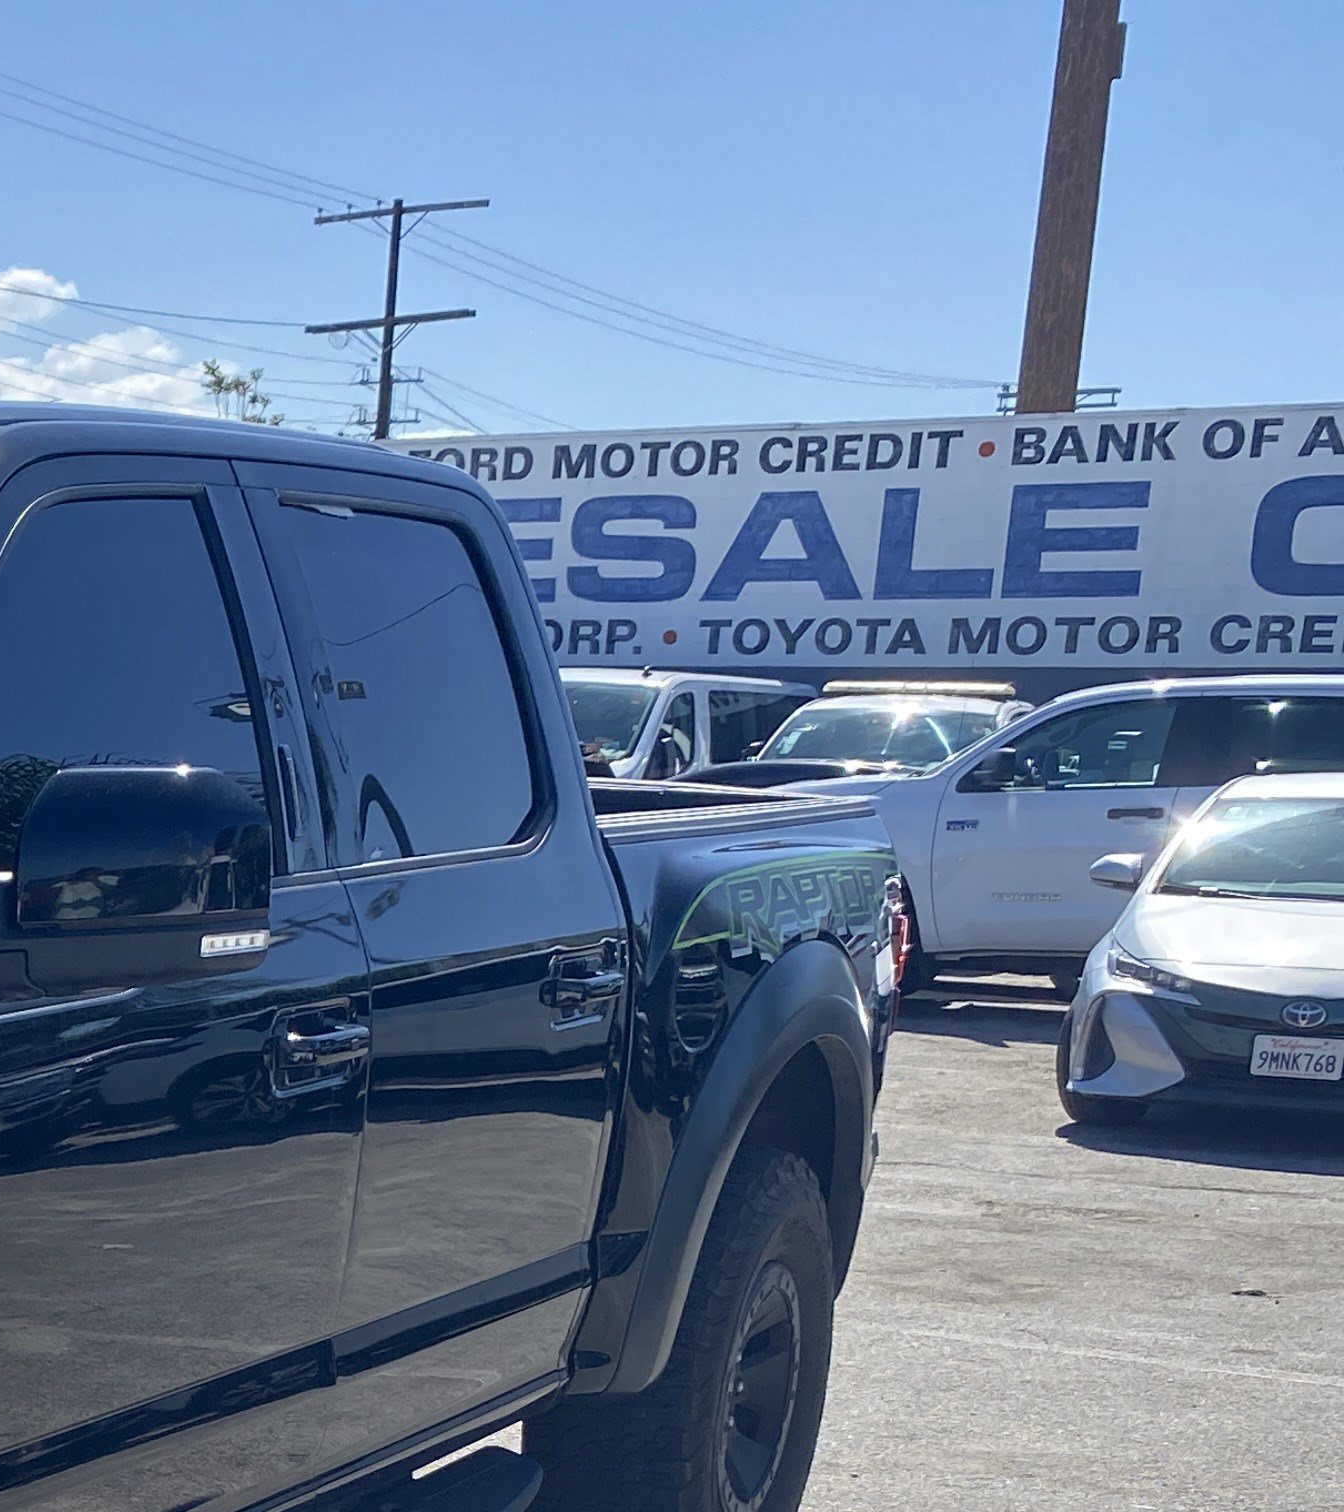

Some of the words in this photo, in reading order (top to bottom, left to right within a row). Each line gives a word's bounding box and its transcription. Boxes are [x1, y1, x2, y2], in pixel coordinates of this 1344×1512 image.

[408, 446, 534, 481] ORD
[552, 440, 740, 478] MOTOR
[759, 430, 964, 474] CREDIT
[1012, 420, 1180, 466] BANK
[1202, 417, 1284, 460] OF
[699, 616, 926, 656] TOYOTA
[948, 615, 1182, 656] MOTOR
[1257, 1050, 1337, 1073] 9MNK768
